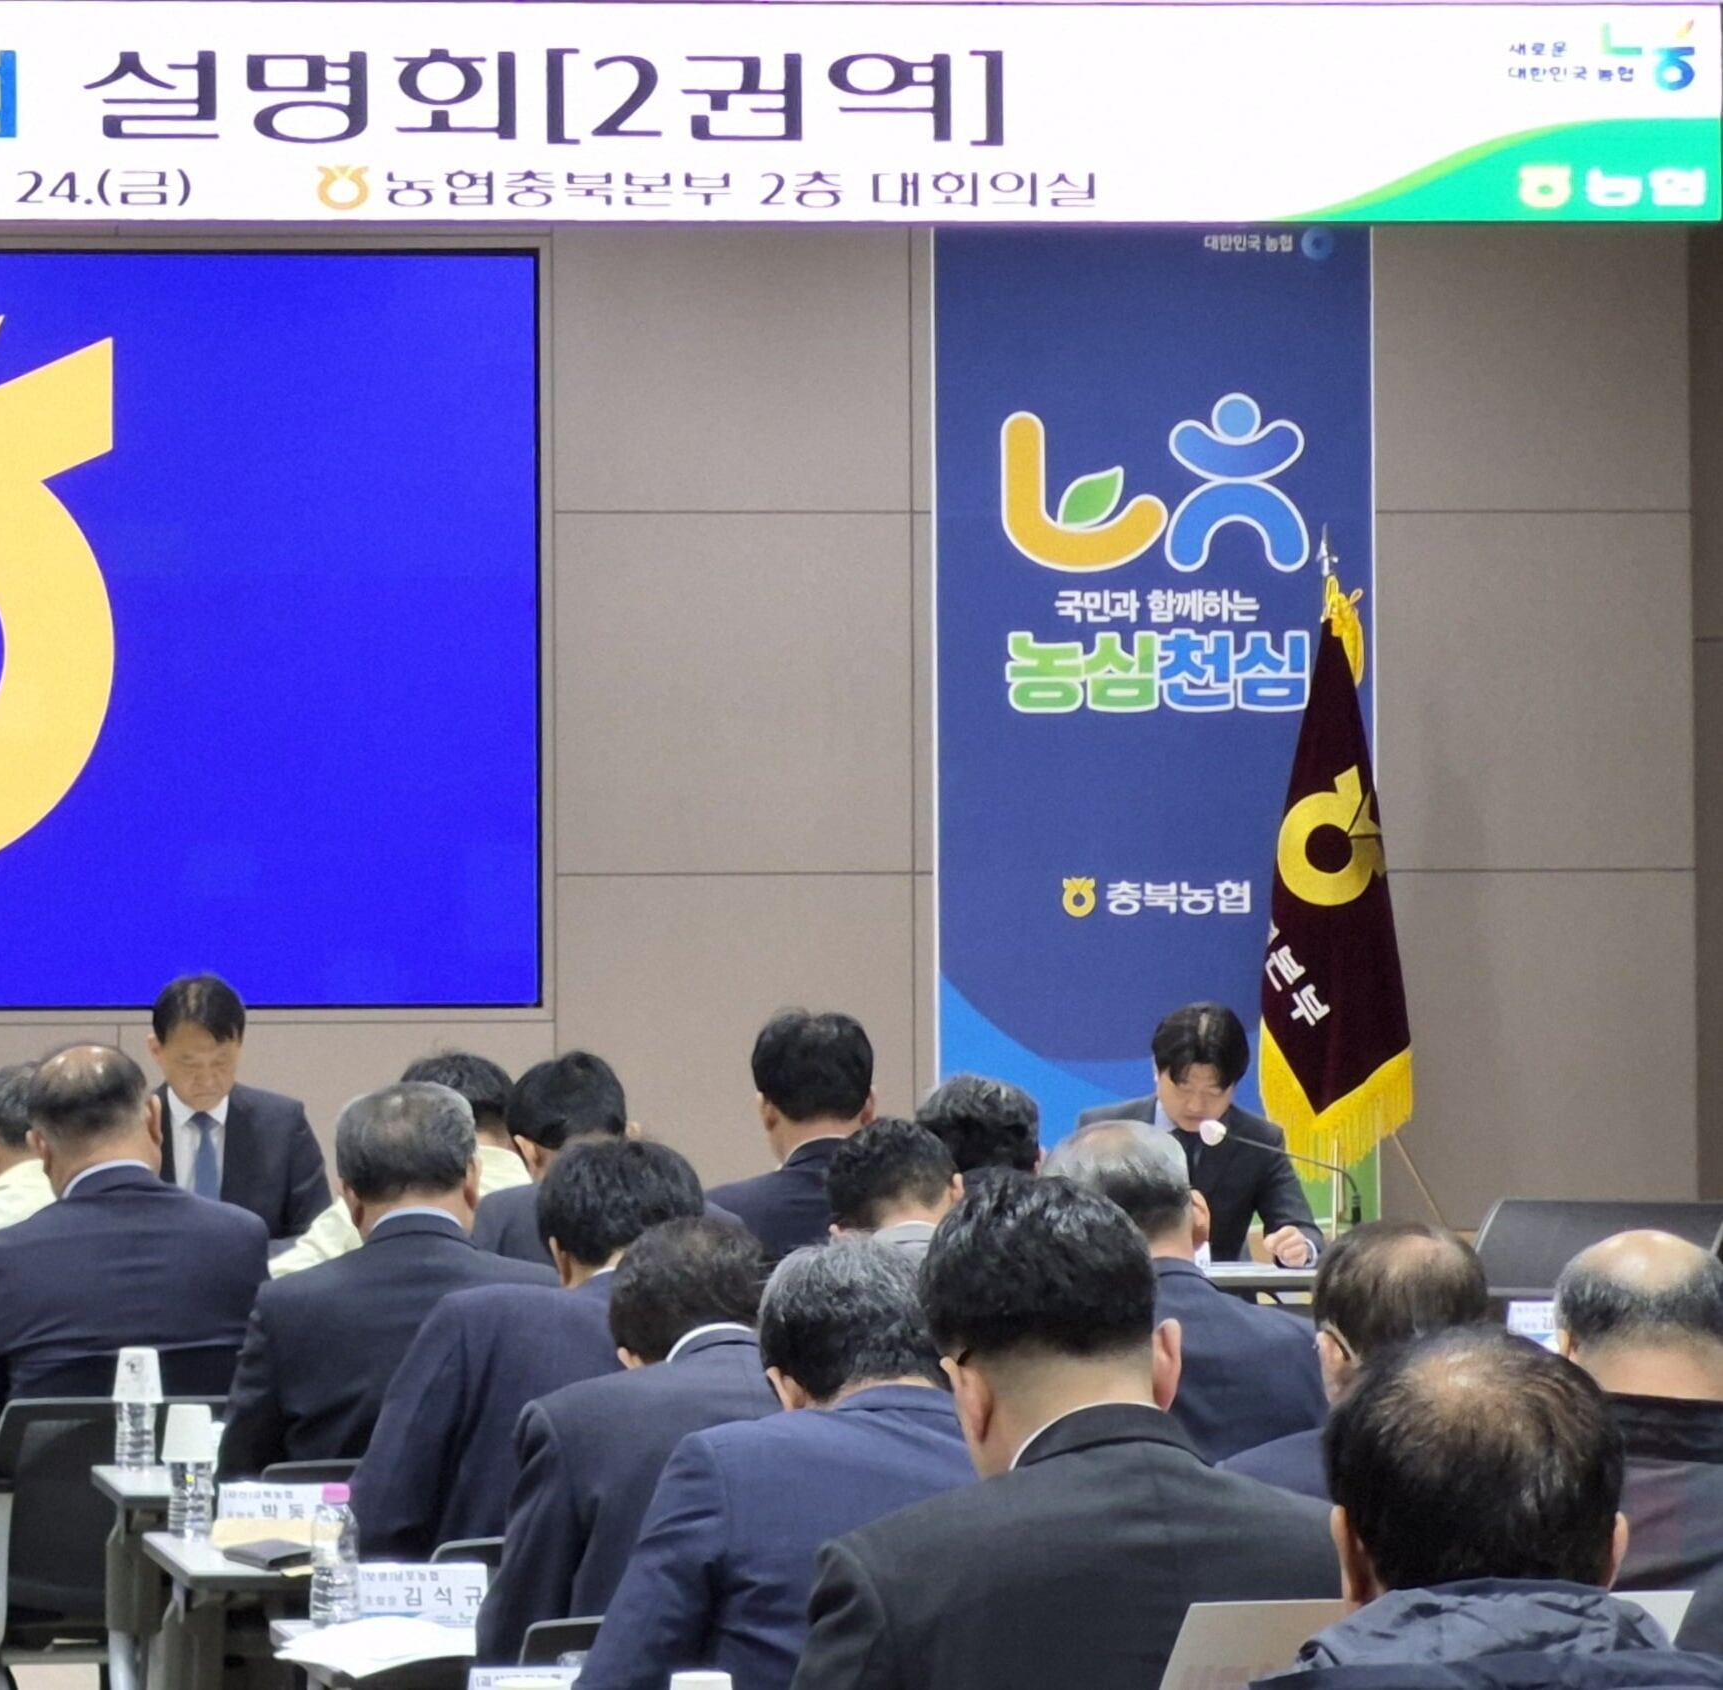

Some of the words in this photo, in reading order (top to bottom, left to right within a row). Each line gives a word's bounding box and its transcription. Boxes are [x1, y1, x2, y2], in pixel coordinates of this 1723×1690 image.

[1509, 41, 1567, 58] 새로운
[1508, 65, 1588, 83] 대한민국
[83, 47, 1004, 147] 설명회[2권역]
[16, 168, 192, 207] 24.(금)
[385, 168, 732, 207] 농협충북본부
[759, 169, 843, 207] 2층
[872, 169, 1097, 208] 대회의실
[1203, 233, 1262, 252] 대한민국
[1054, 588, 1141, 623] 국민과
[1145, 587, 1261, 624] 함께하는
[1005, 630, 1311, 714] 농심천심
[1106, 879, 1252, 917] 충북농협
